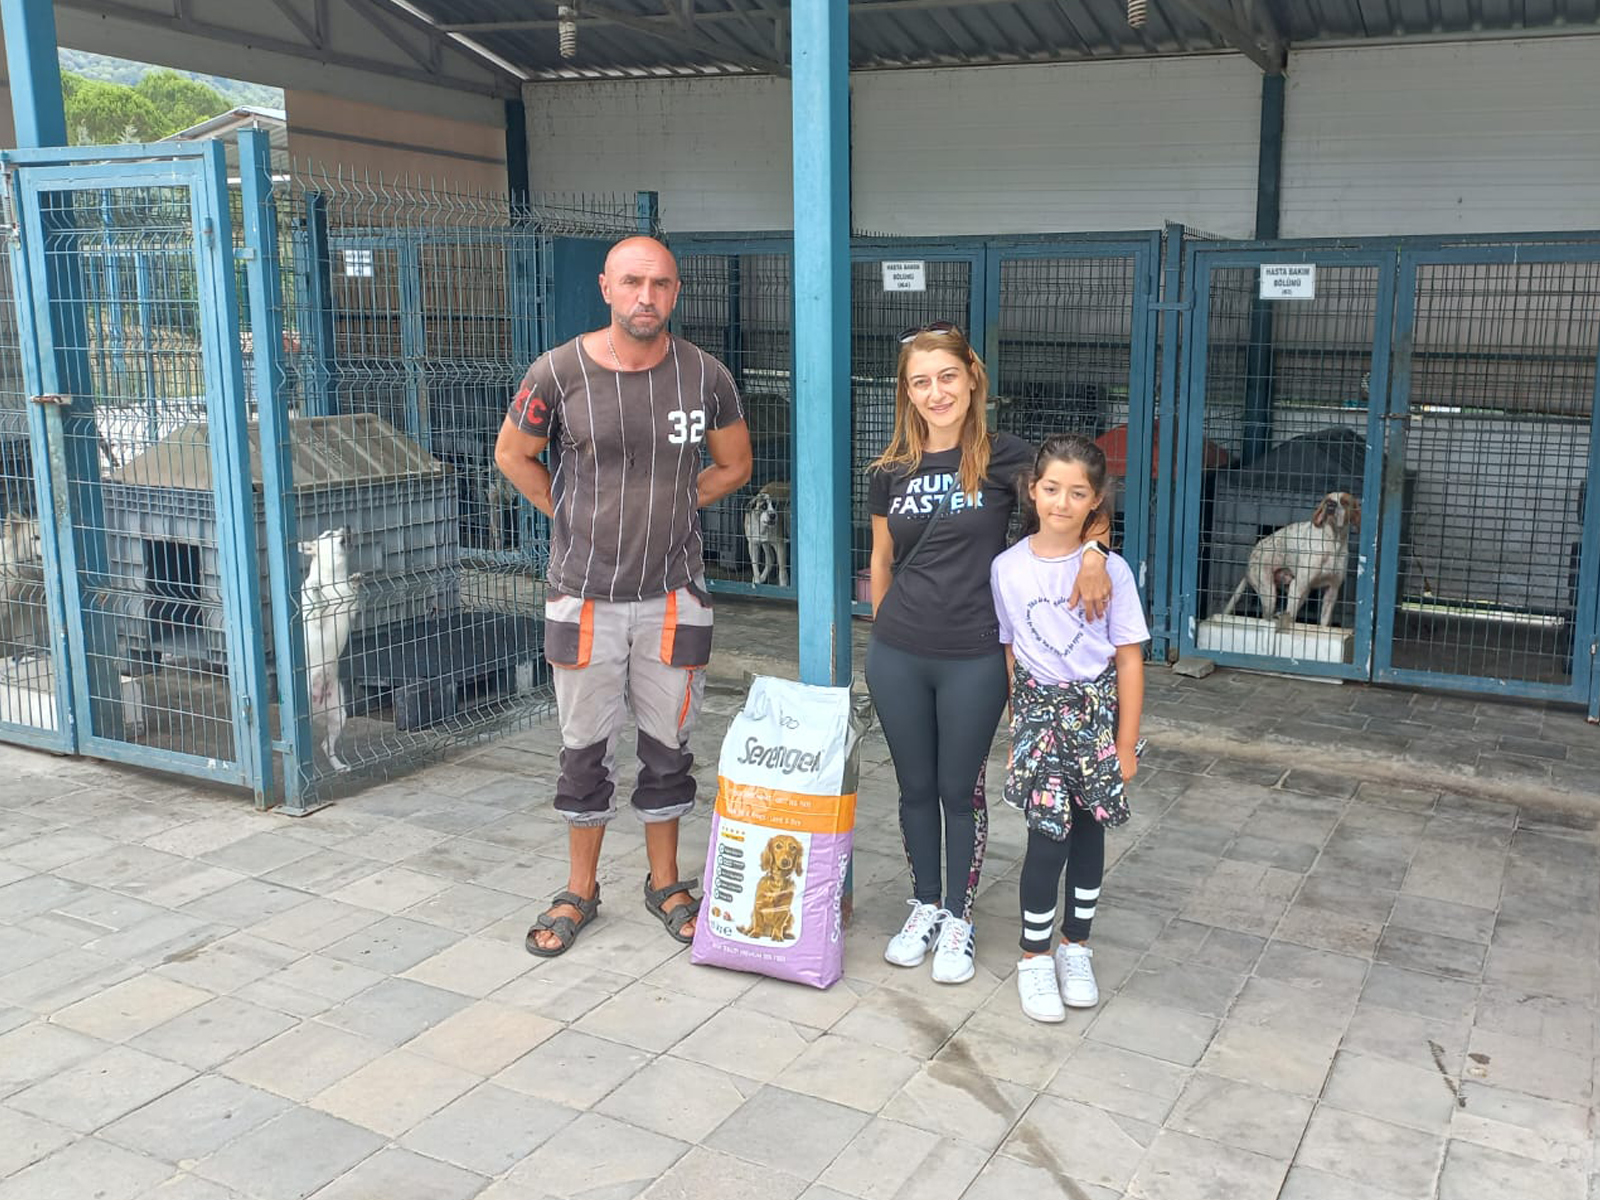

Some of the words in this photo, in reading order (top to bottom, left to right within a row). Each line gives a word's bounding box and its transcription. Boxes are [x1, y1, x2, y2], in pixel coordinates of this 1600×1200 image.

[1273, 277, 1301, 287] BÖLÜMÜ
[667, 409, 706, 444] 32
[889, 491, 984, 515] FASTER
